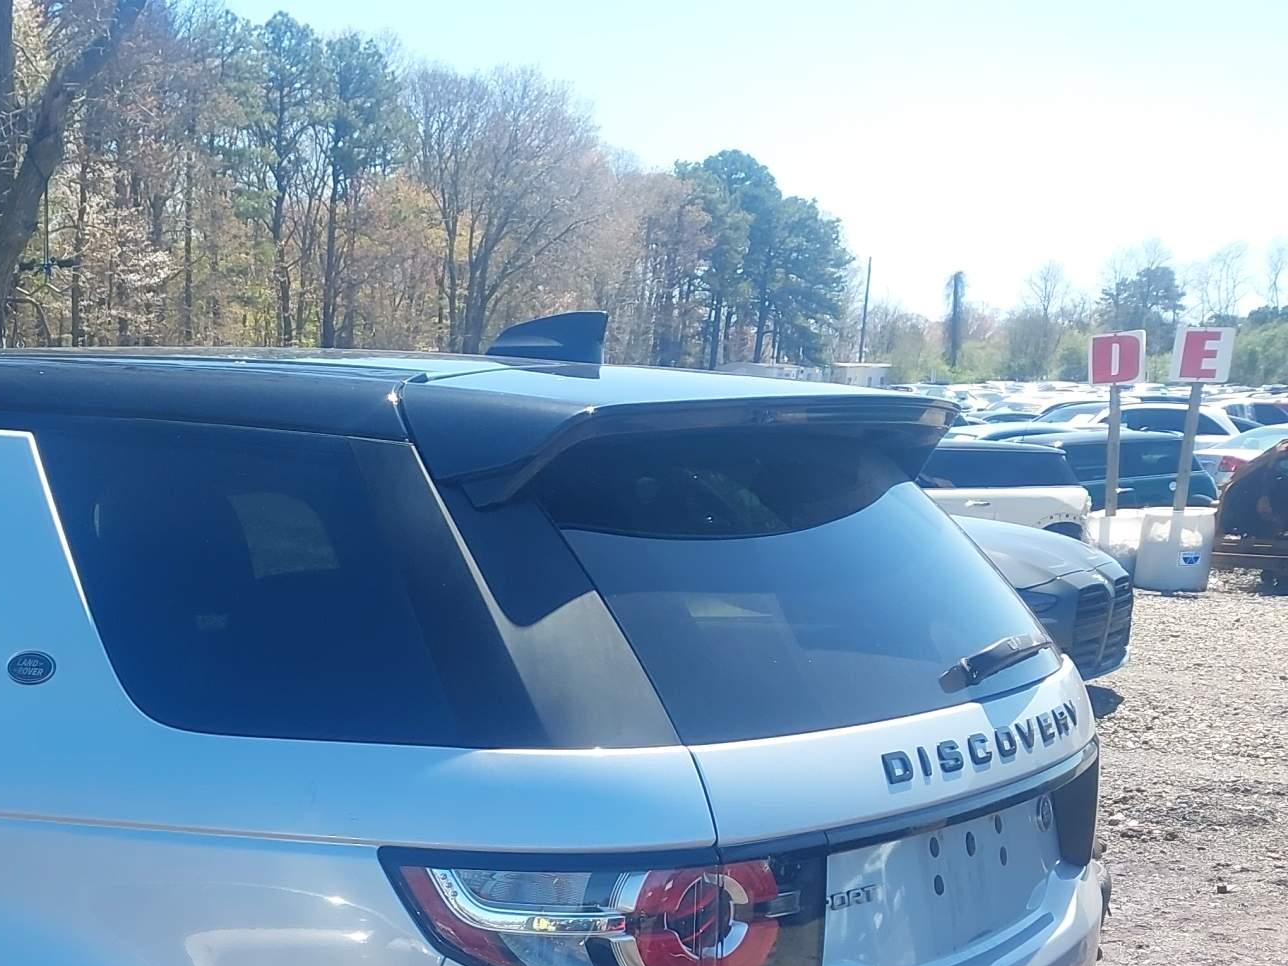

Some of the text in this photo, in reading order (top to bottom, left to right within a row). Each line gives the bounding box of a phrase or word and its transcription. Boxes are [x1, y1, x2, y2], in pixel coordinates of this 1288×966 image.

[1092, 335, 1141, 385] D
[1179, 330, 1222, 379] E
[881, 699, 1078, 785] DISCOVERY
